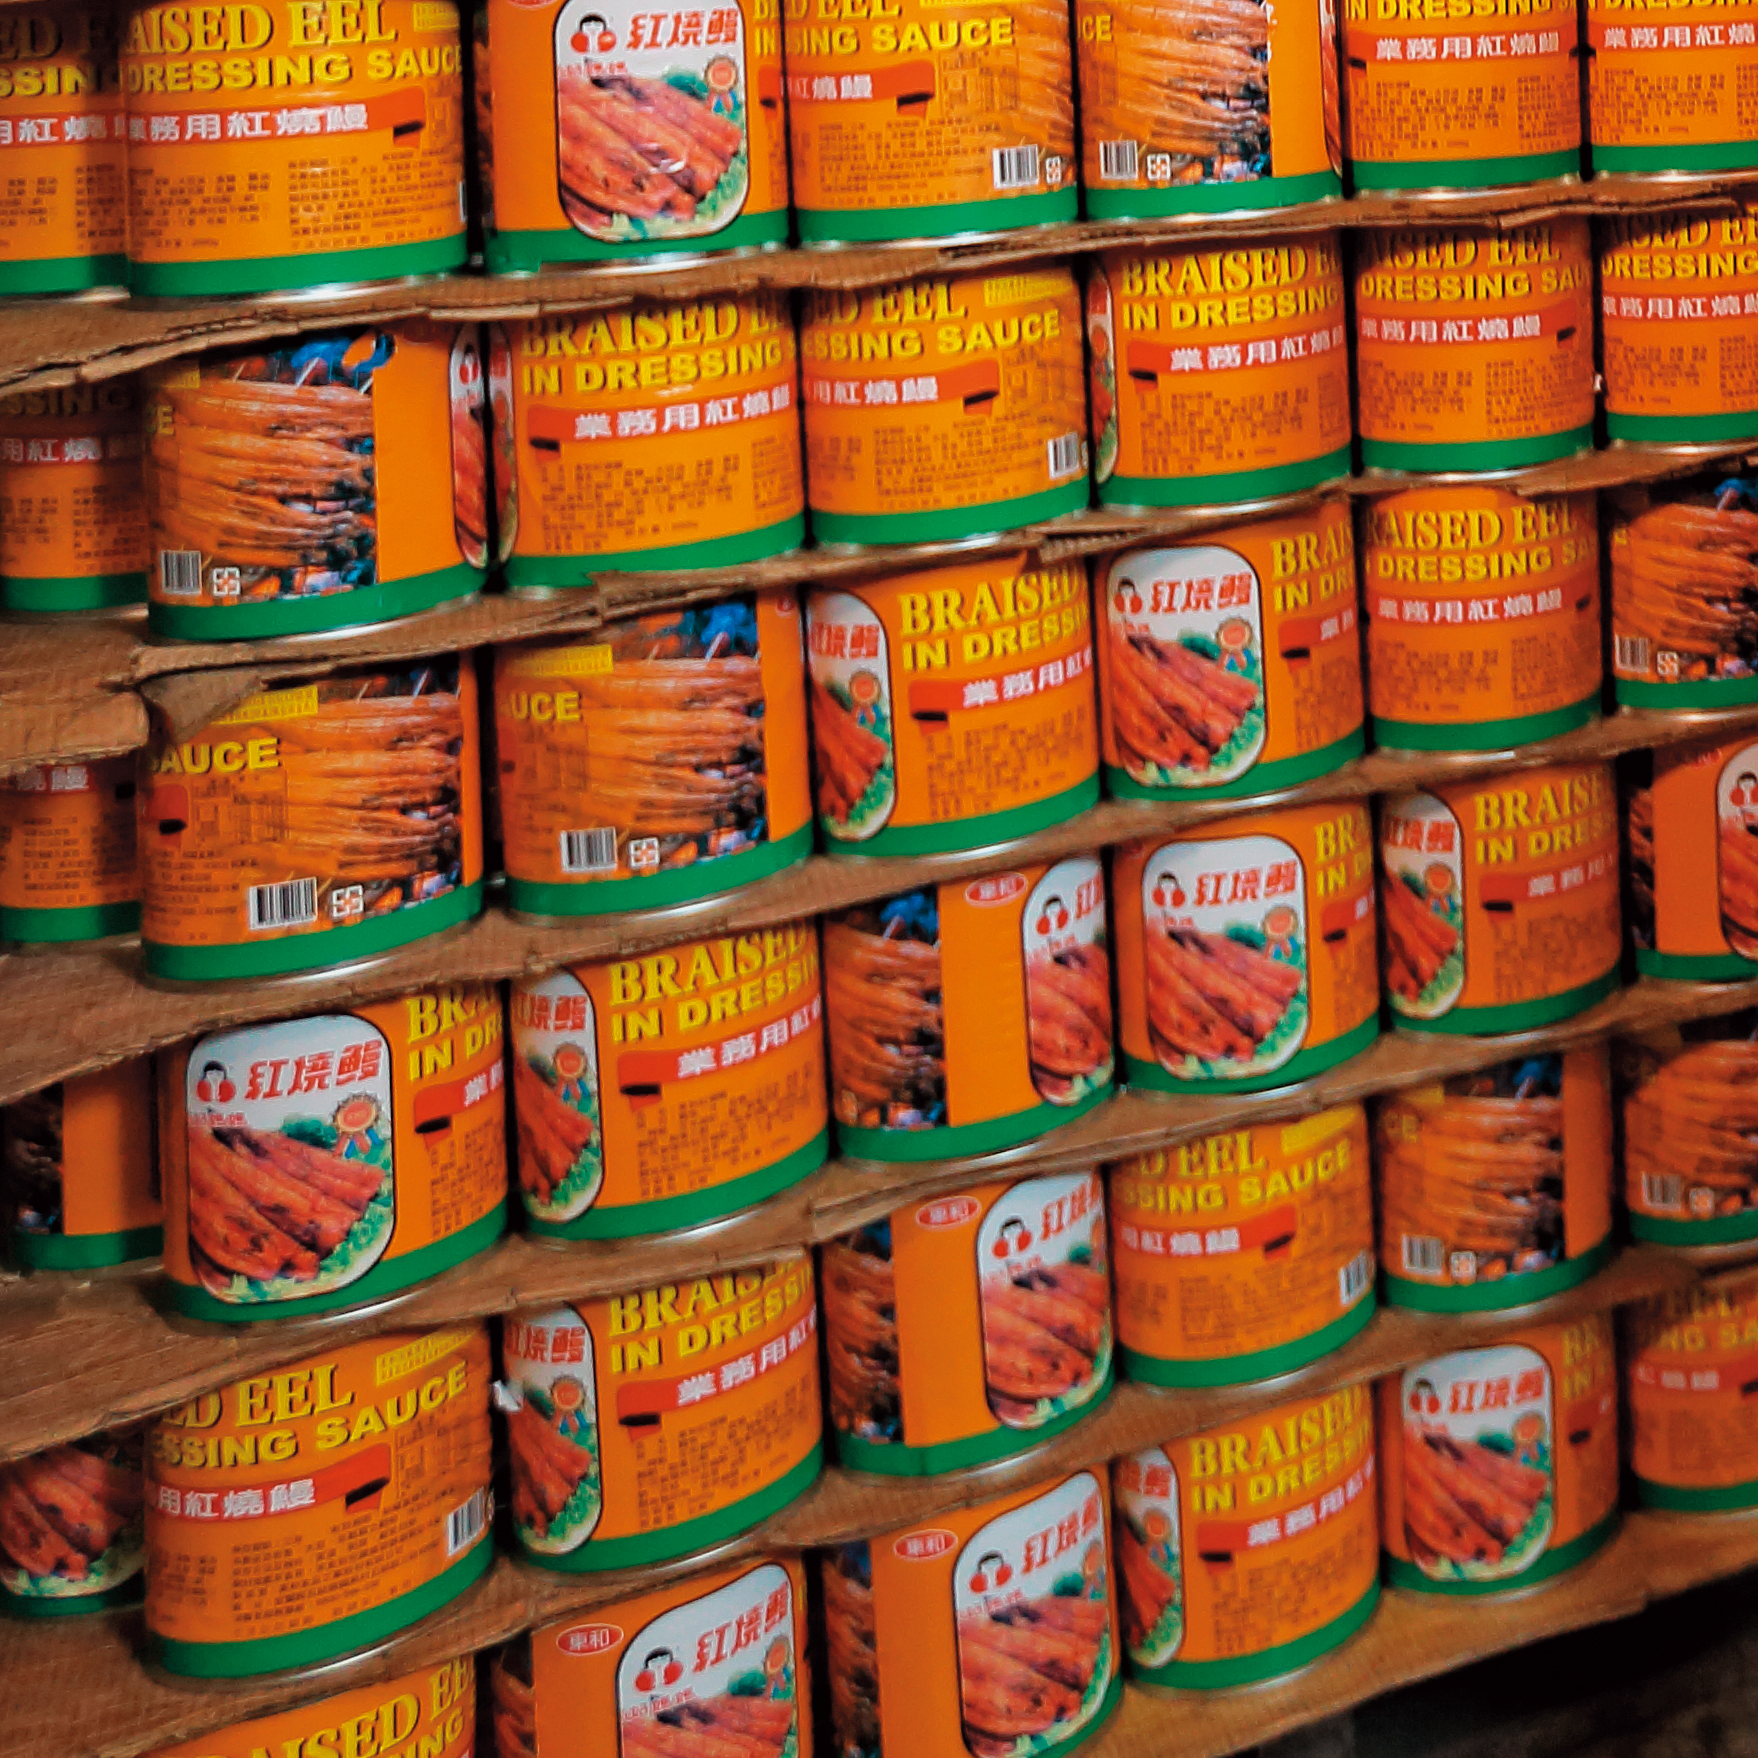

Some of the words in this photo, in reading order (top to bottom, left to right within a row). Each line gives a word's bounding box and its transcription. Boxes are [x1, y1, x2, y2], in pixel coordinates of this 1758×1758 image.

[627, 7, 738, 51] 紅燒鰻
[871, 15, 1015, 53] SAUCE
[1375, 30, 1561, 62] 業務用紅燒鰻
[1117, 246, 1307, 297] BRAISED
[1361, 269, 1531, 303] DRESSING
[871, 278, 968, 324] EEL
[1121, 299, 1158, 332] IN
[1168, 283, 1340, 330] DRESSING
[521, 298, 739, 360] BRAISED
[936, 309, 1061, 355] SAUCE
[522, 364, 562, 396] IN
[574, 340, 782, 394] DRESSING
[1511, 500, 1579, 545] EEL
[1378, 551, 1552, 583] DRESSING
[1149, 571, 1253, 617] 紅燒鰻
[1272, 578, 1310, 612] IN
[1377, 588, 1563, 624] 業務用紅燒鰻
[901, 638, 948, 674] IN
[1476, 836, 1515, 865] IN
[609, 924, 808, 1007] BRAISED
[610, 1007, 662, 1043] IN
[243, 1037, 383, 1102] 紅燒鰻
[408, 1041, 454, 1080] IN
[1238, 1145, 1351, 1211] SAUCE
[609, 1334, 660, 1375] IN
[234, 1361, 355, 1429] EEL
[316, 1358, 469, 1448] SAUCE
[1447, 1367, 1547, 1416] 紅燒鰻
[158, 1477, 317, 1520] 用紅燒鰻
[1191, 1478, 1239, 1515] IN
[569, 1626, 611, 1653] 東和
[692, 1579, 791, 1675] 紅燒鰻
